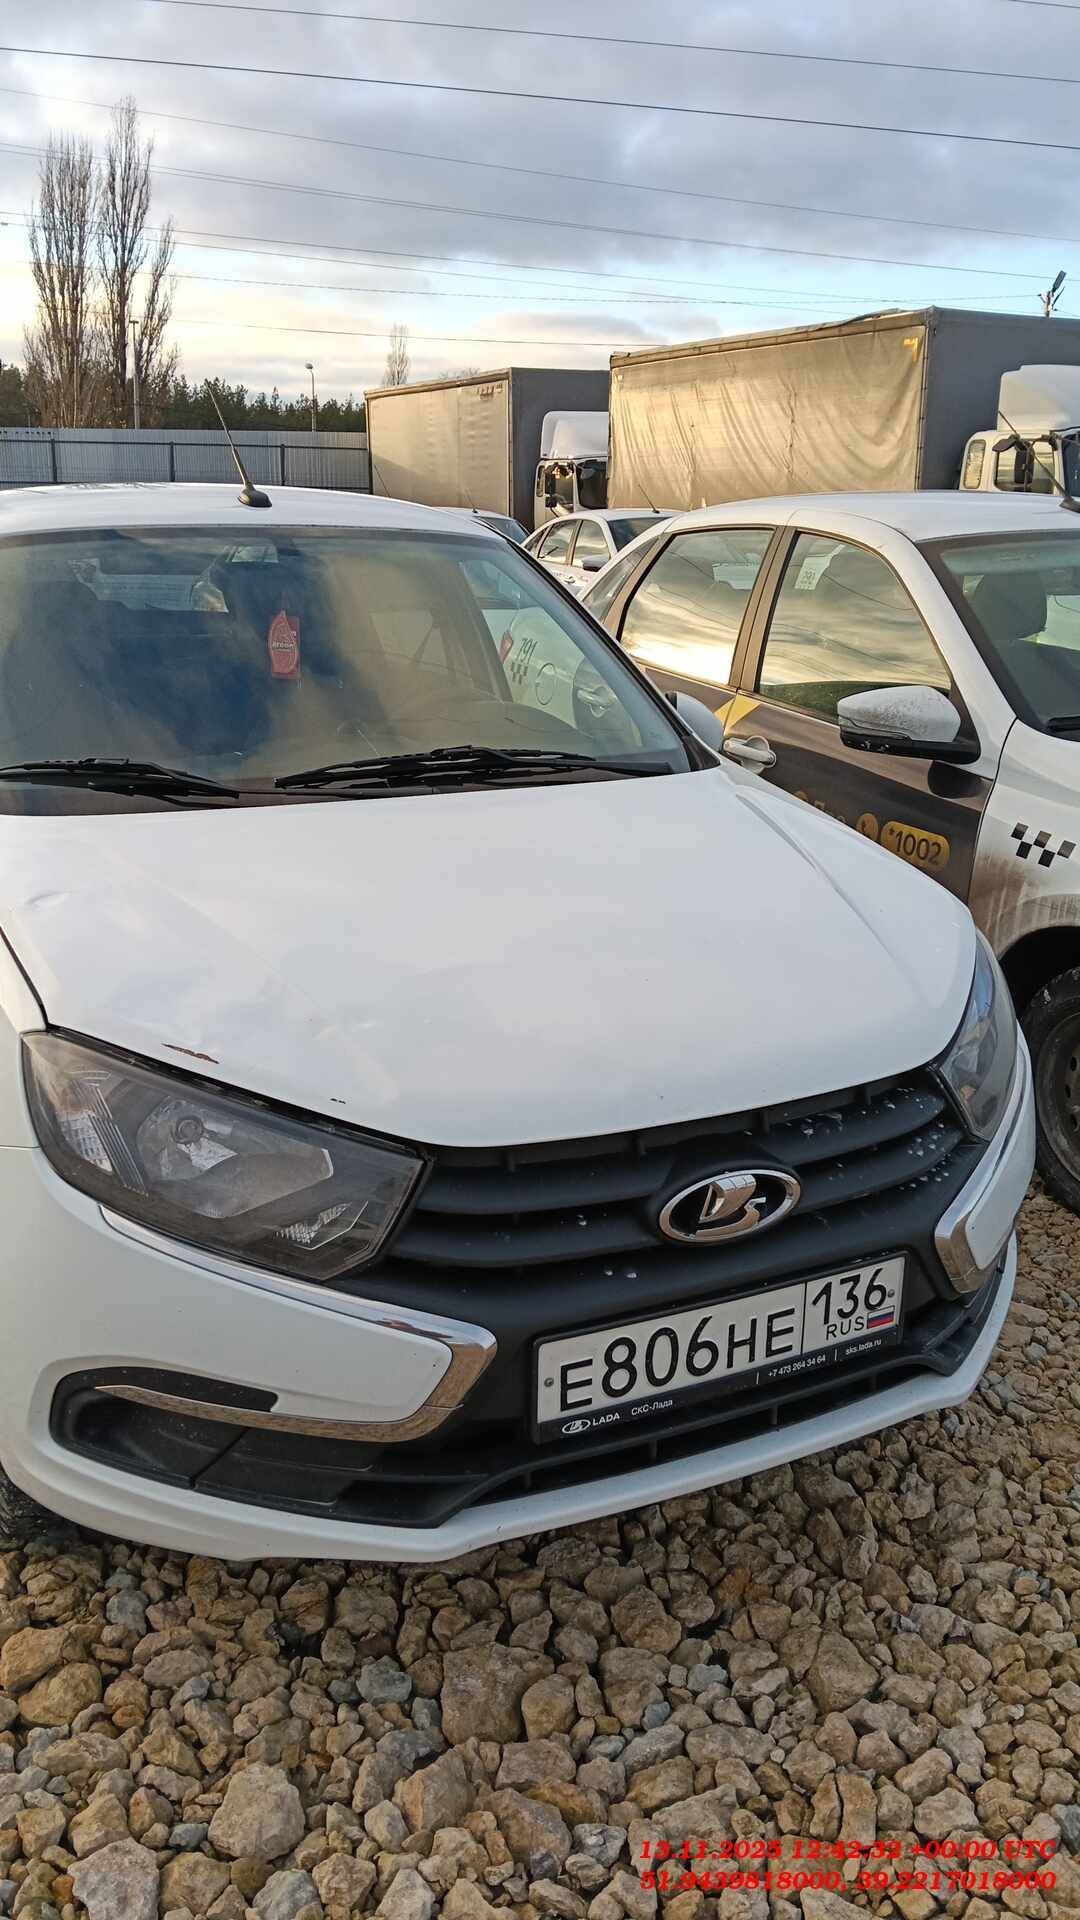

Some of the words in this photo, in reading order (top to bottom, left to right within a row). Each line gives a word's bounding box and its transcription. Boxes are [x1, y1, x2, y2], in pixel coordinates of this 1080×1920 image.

[811, 1268, 888, 1326] 136
[825, 1317, 865, 1340] RUS
[845, 1338, 882, 1355] sks.lada.ru
[631, 1400, 673, 1415] СКС-Лада
[592, 1412, 620, 1426] LADA
